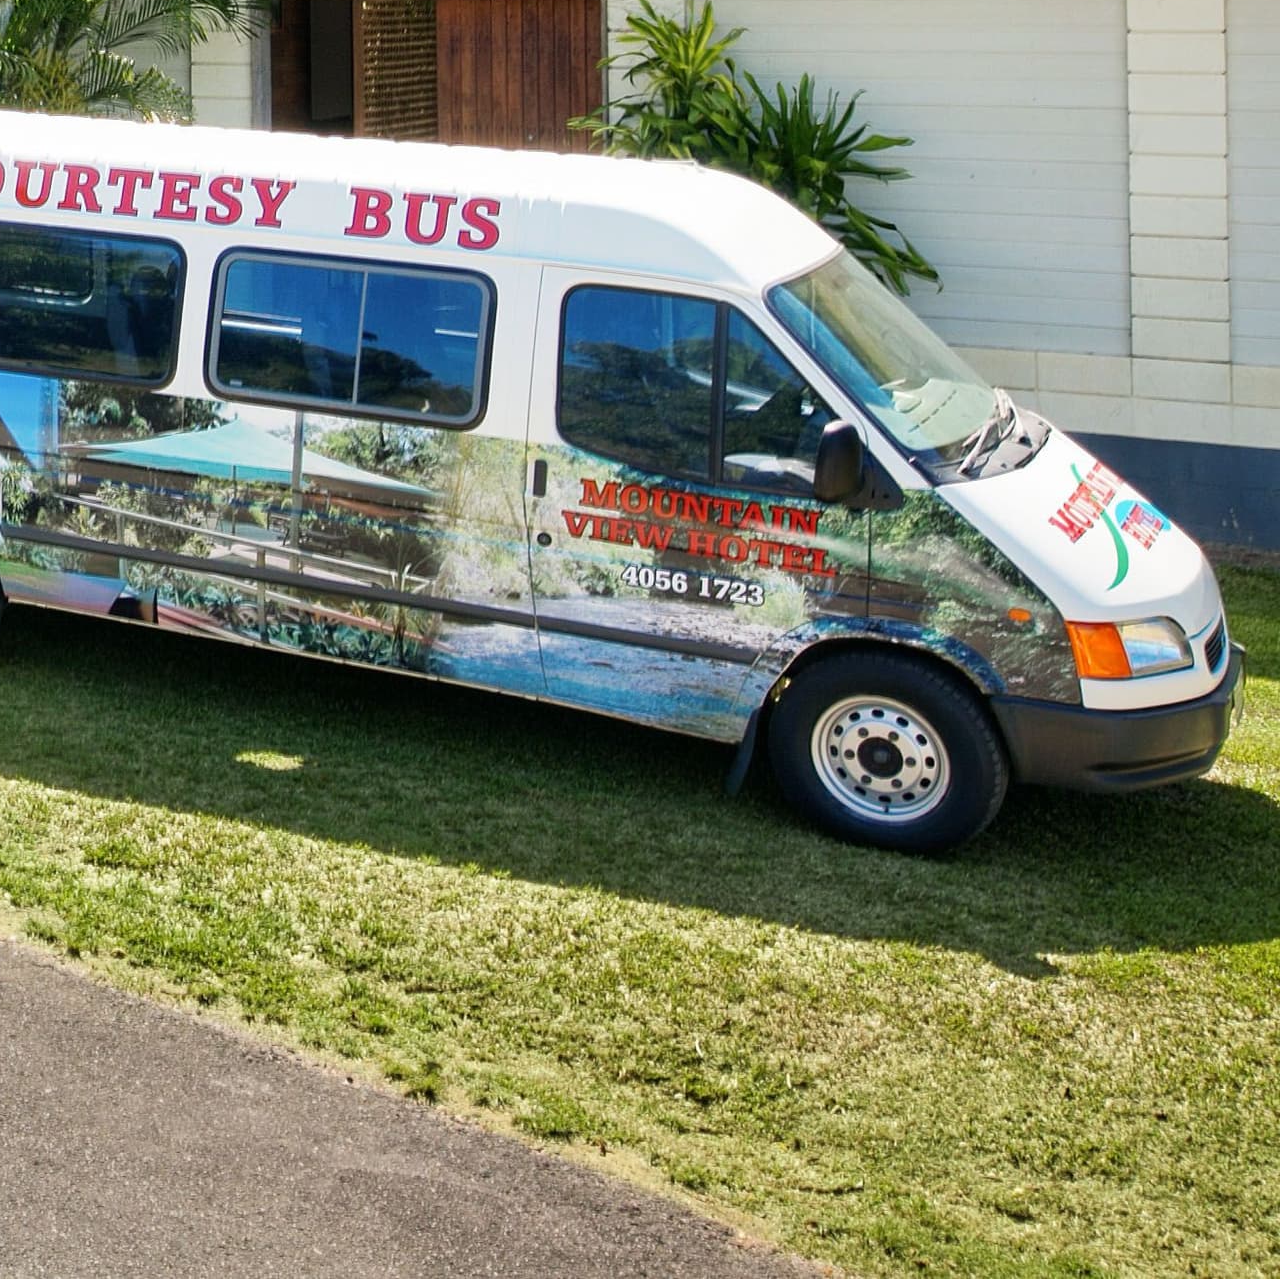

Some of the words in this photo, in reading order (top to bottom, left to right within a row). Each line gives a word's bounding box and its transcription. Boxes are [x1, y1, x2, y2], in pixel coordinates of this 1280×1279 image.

[343, 185, 501, 251] BUS
[578, 478, 822, 538] MOUNTAIN
[561, 510, 674, 553] VIEW
[686, 528, 838, 578] HOTEL
[620, 564, 689, 595] 4056
[697, 575, 766, 607] 1723
